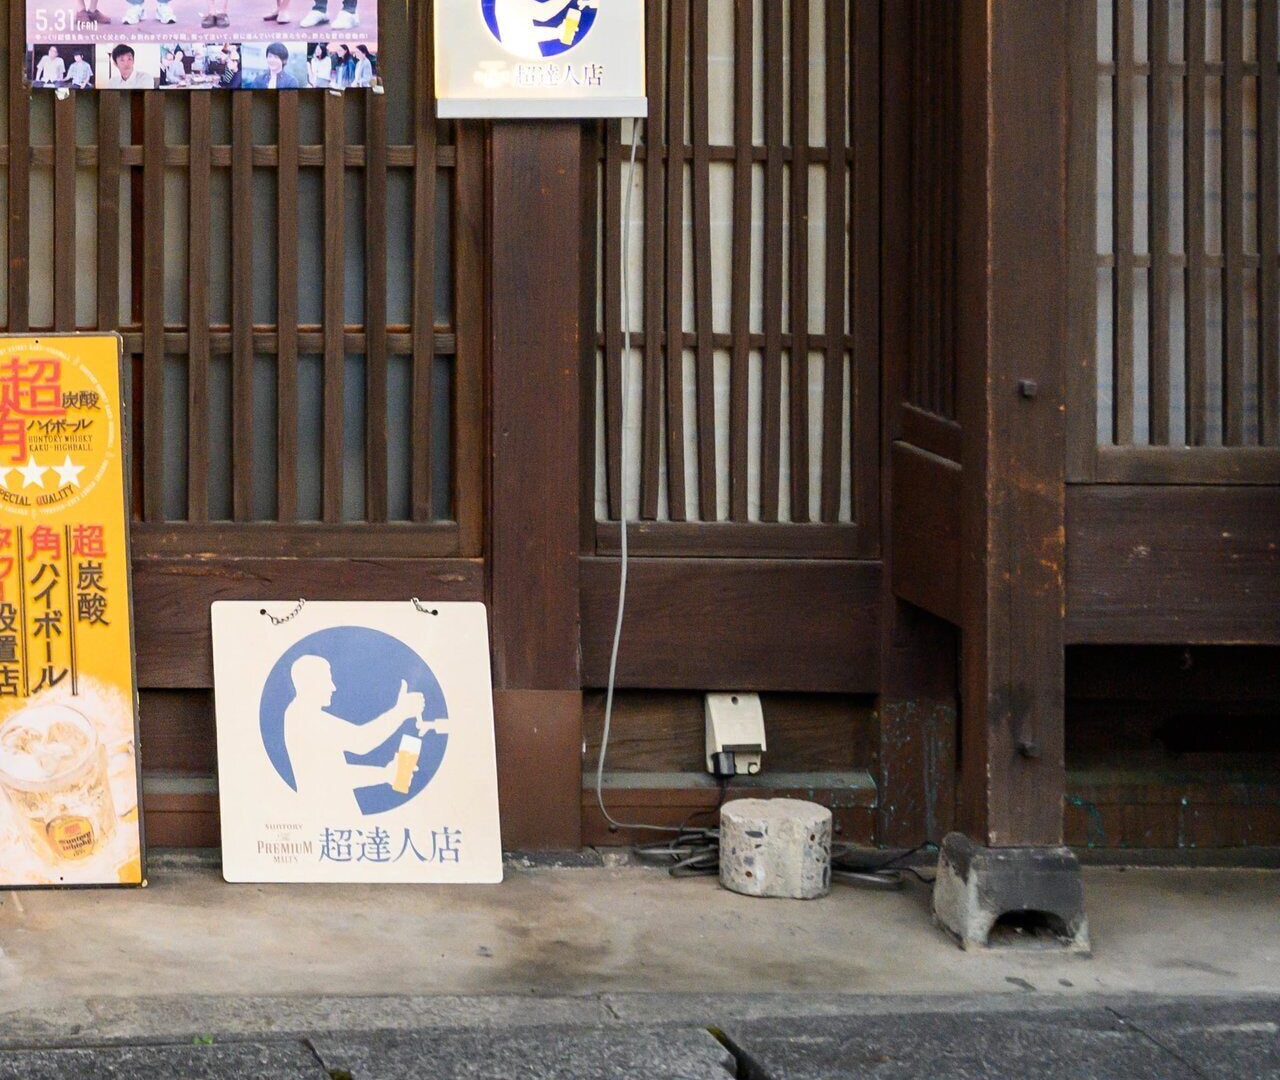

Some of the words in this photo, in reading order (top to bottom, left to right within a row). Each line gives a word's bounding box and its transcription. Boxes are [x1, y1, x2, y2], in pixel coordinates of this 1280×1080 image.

[35, 9, 74, 31] 5.31
[62, 390, 100, 410] 炭酸
[26, 417, 94, 435] ハイボール
[36, 484, 75, 507] QUALITY
[73, 524, 109, 626] 超炭酸
[27, 524, 68, 695] 角ハイボール
[264, 823, 304, 831] SUNTORY
[256, 840, 313, 855] PREMIUM
[318, 826, 462, 864] 超達人店
